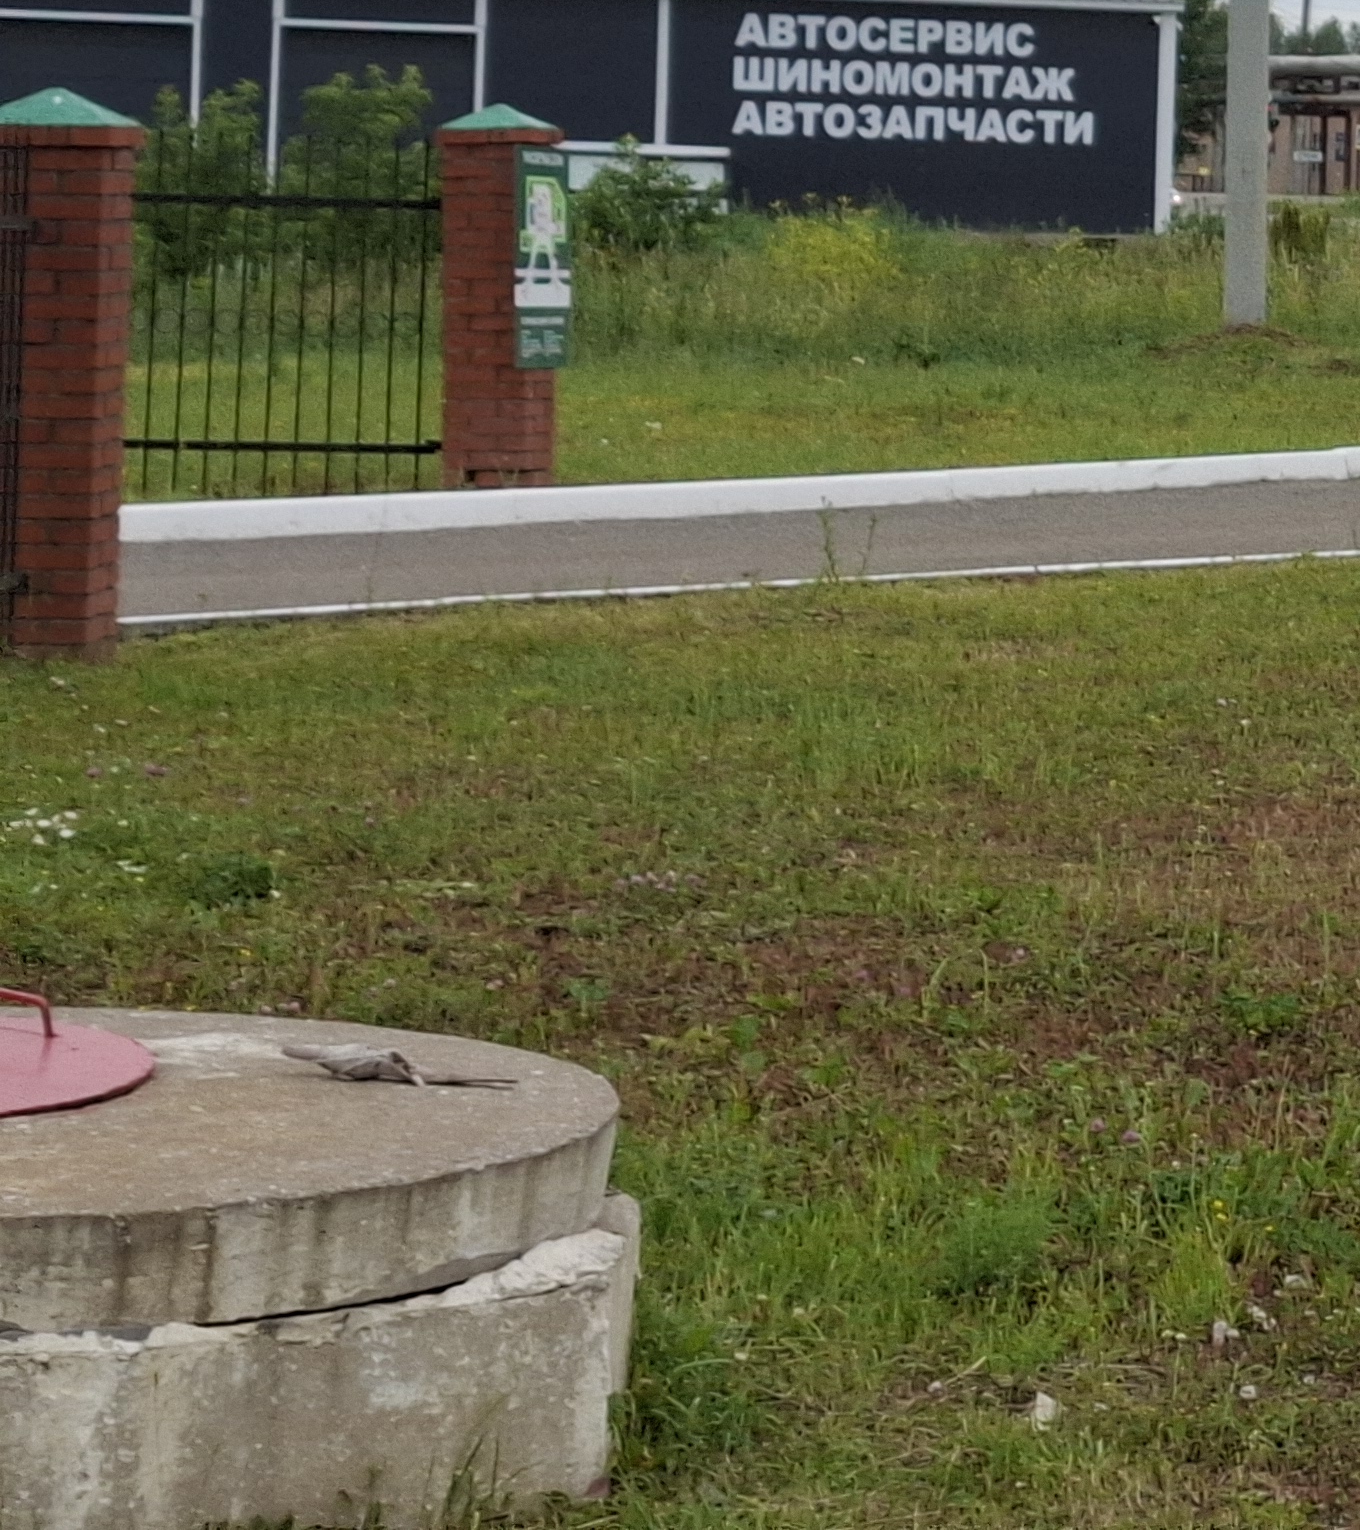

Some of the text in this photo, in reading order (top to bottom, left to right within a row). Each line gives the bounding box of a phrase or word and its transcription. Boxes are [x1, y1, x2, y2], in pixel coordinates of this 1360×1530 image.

[734, 11, 1036, 58] АВТОСЕРВИС
[732, 55, 1076, 102] ШИНОМОНТАЖ
[731, 100, 1095, 146] АВТОЗАПЧАСТИ
